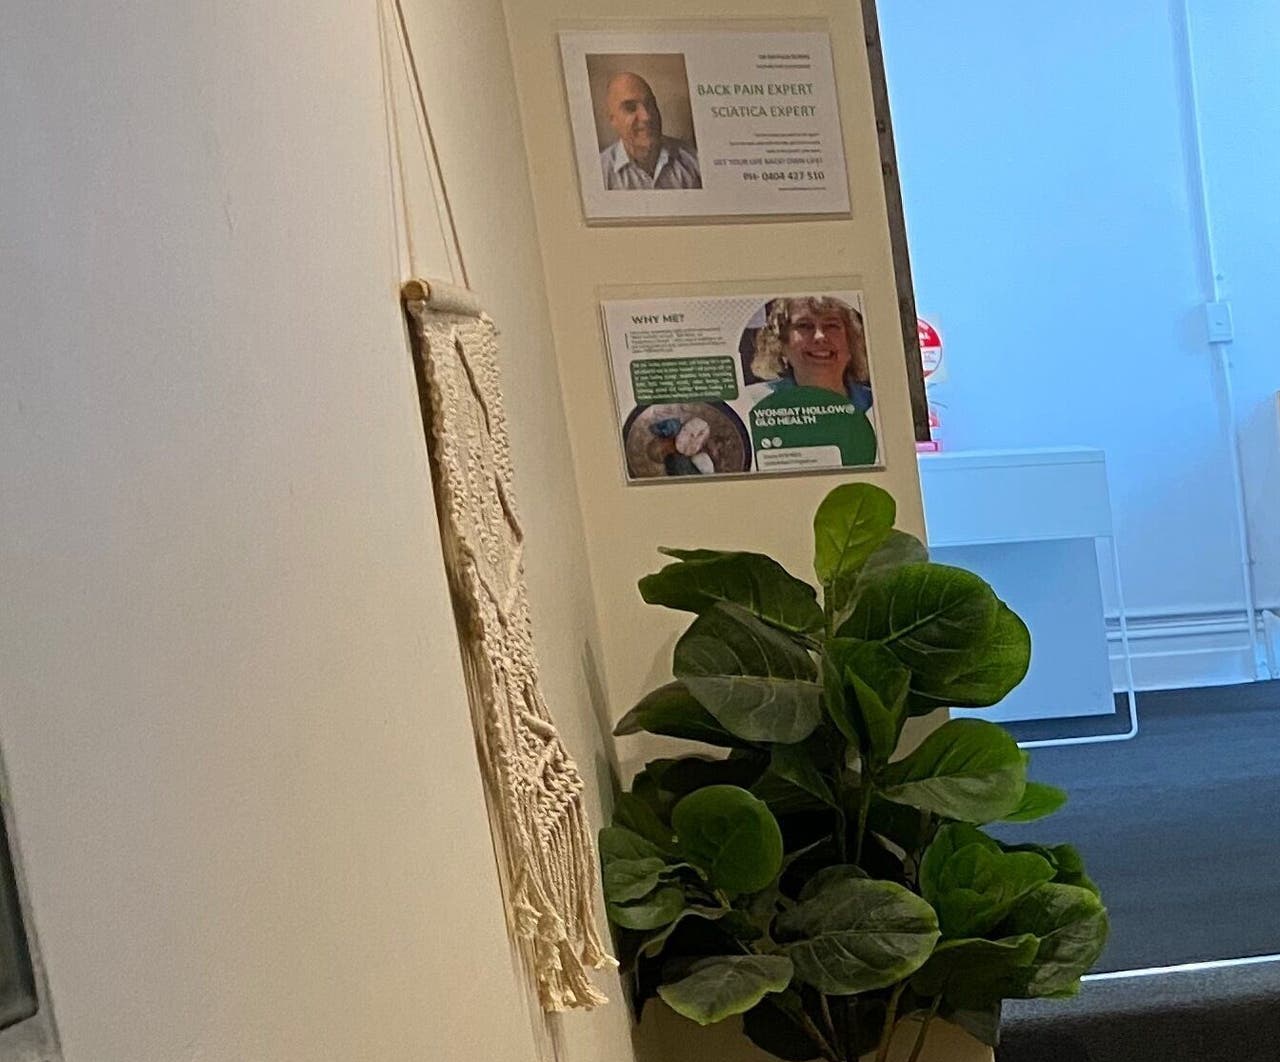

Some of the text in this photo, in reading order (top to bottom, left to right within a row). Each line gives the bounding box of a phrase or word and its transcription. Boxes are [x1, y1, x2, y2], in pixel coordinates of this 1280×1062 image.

[697, 83, 813, 96] BACK PAIN EXPERT
[711, 105, 816, 118] SCIATICA EXPERT
[777, 415, 817, 426] HEALTH
